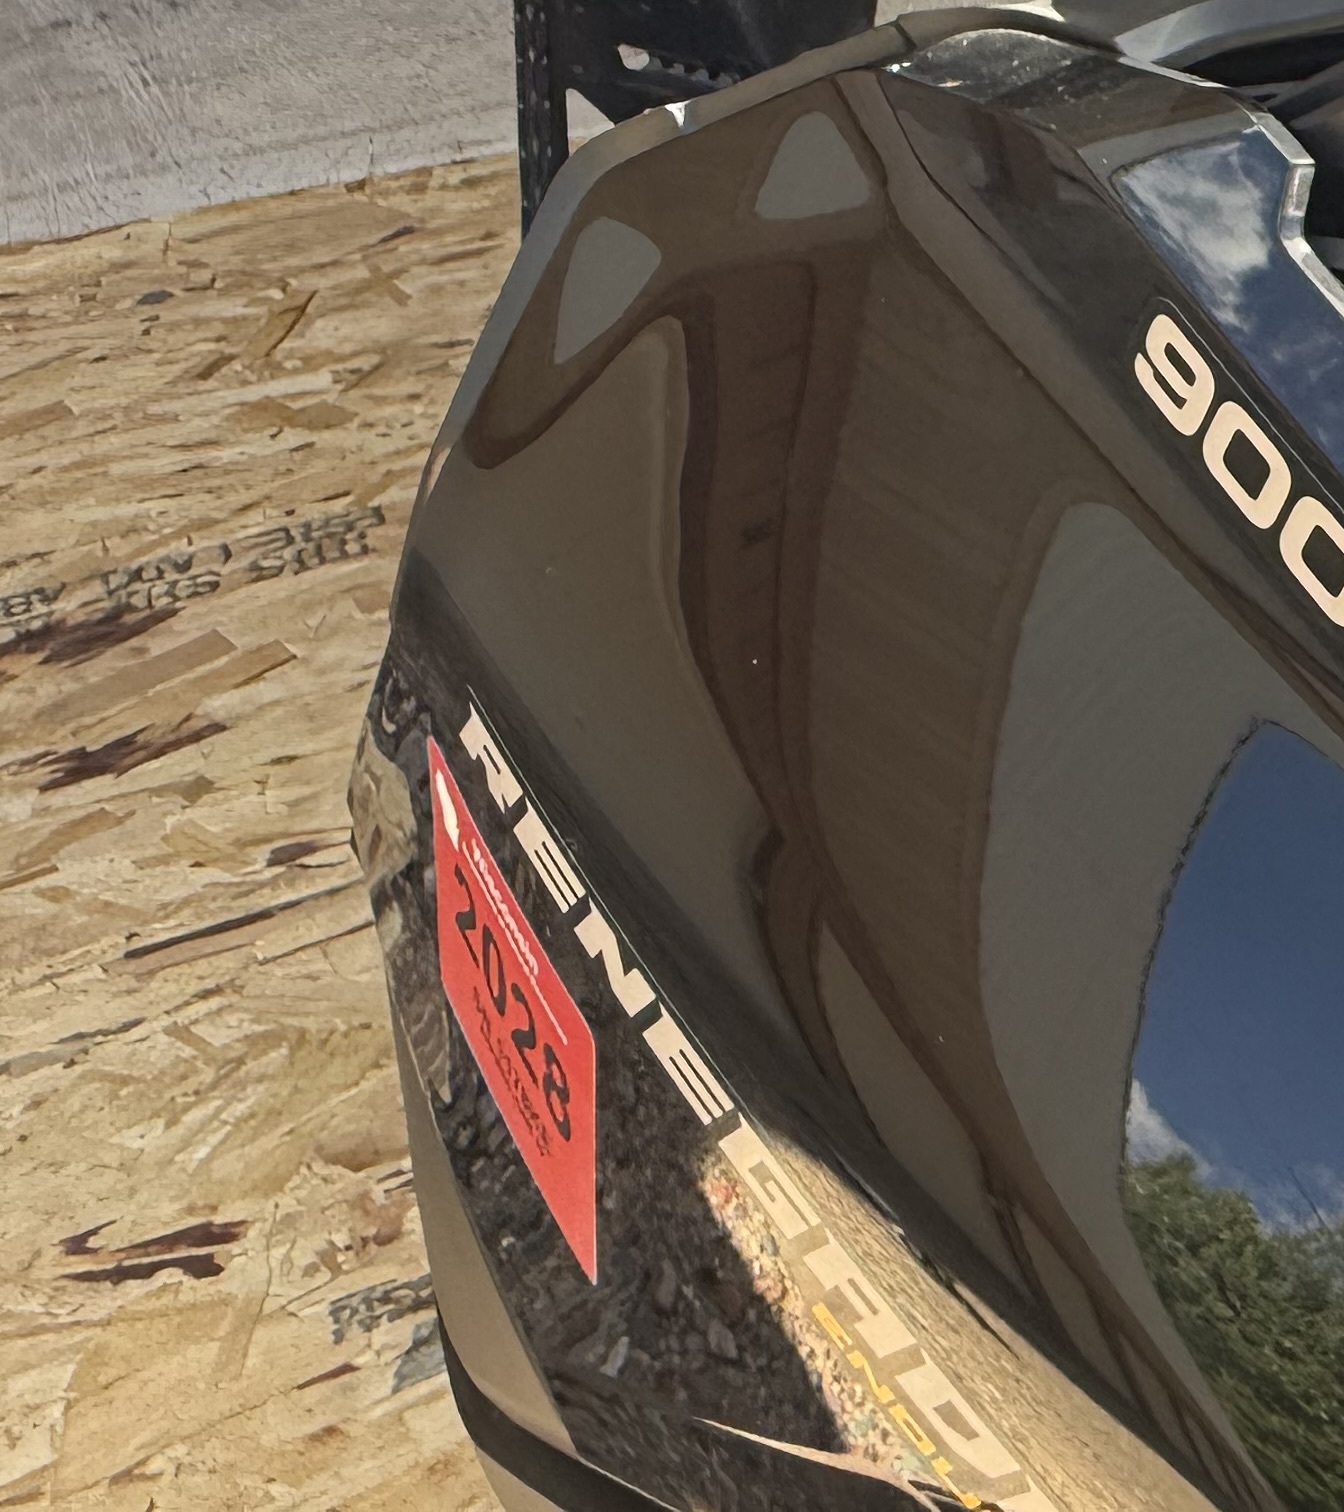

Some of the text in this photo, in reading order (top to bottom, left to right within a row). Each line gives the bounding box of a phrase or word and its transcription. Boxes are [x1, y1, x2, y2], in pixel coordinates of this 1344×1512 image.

[455, 862, 572, 1143] 2028
[459, 701, 1060, 1512] RENEGAD
[811, 1301, 992, 1512] ENDU
